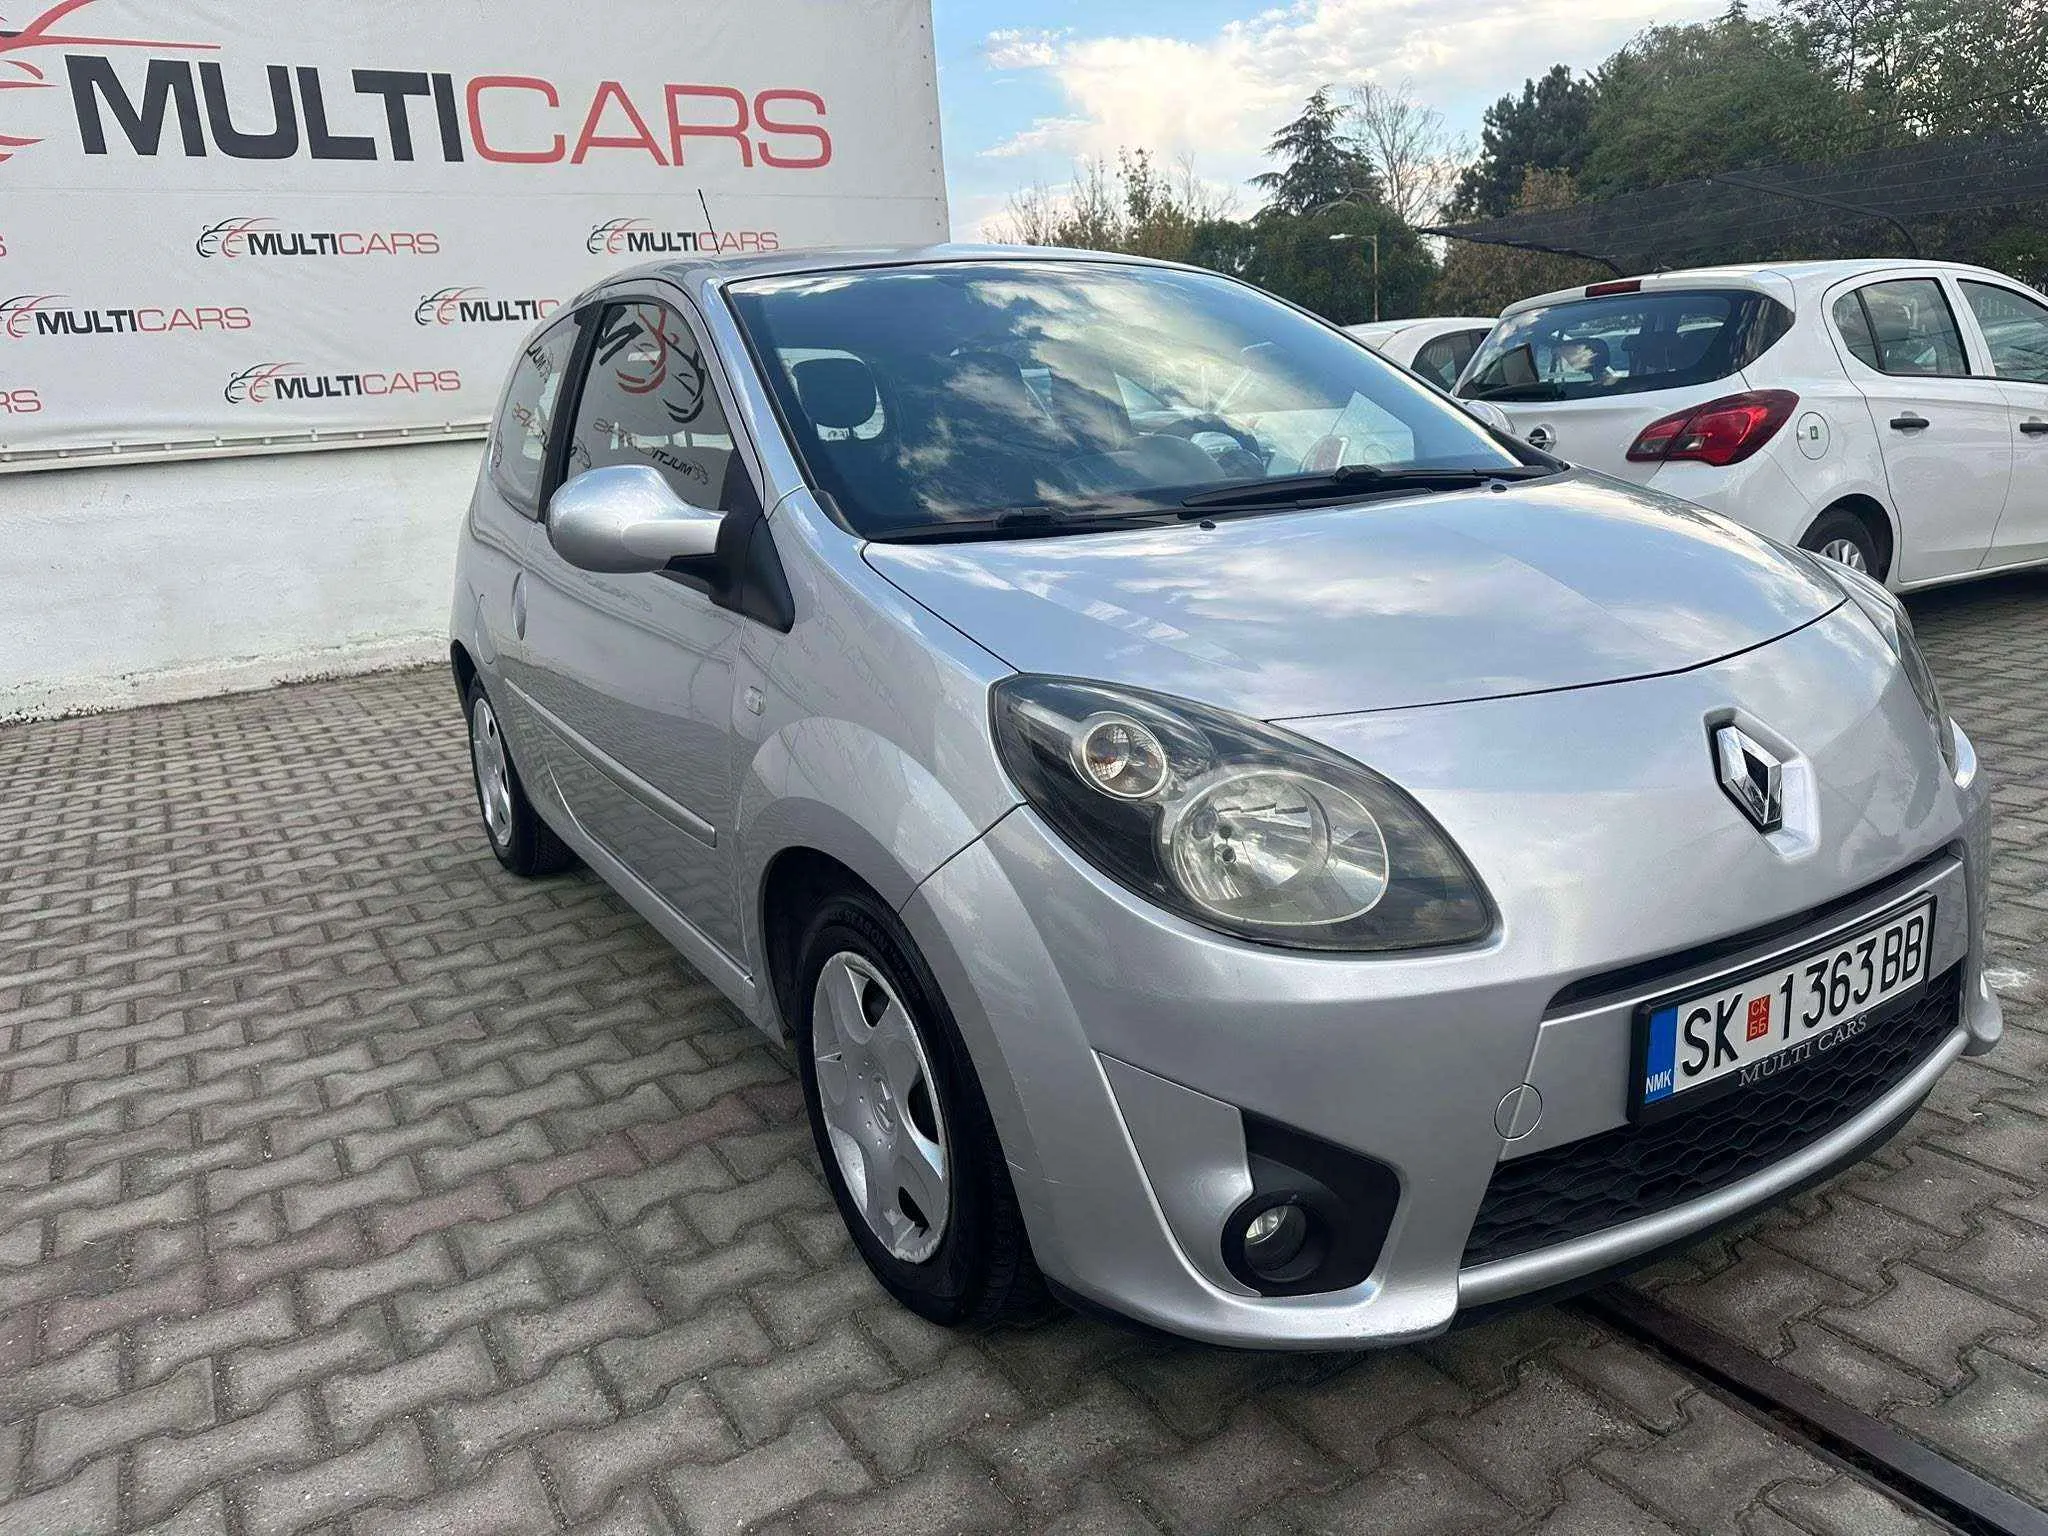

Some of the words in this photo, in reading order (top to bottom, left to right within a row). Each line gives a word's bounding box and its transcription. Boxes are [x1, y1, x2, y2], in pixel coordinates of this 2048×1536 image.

[64, 54, 832, 169] MULTICARS
[247, 232, 440, 257] MULTICARS
[627, 231, 779, 252] MULTICARS
[35, 306, 252, 336] MULTICARS
[274, 369, 461, 400] MULTICARS
[1681, 993, 1743, 1077] SK
[1738, 1041, 1812, 1087] MULTI
[1817, 1014, 1868, 1051] CARS
[1645, 1068, 1672, 1095] NMK
